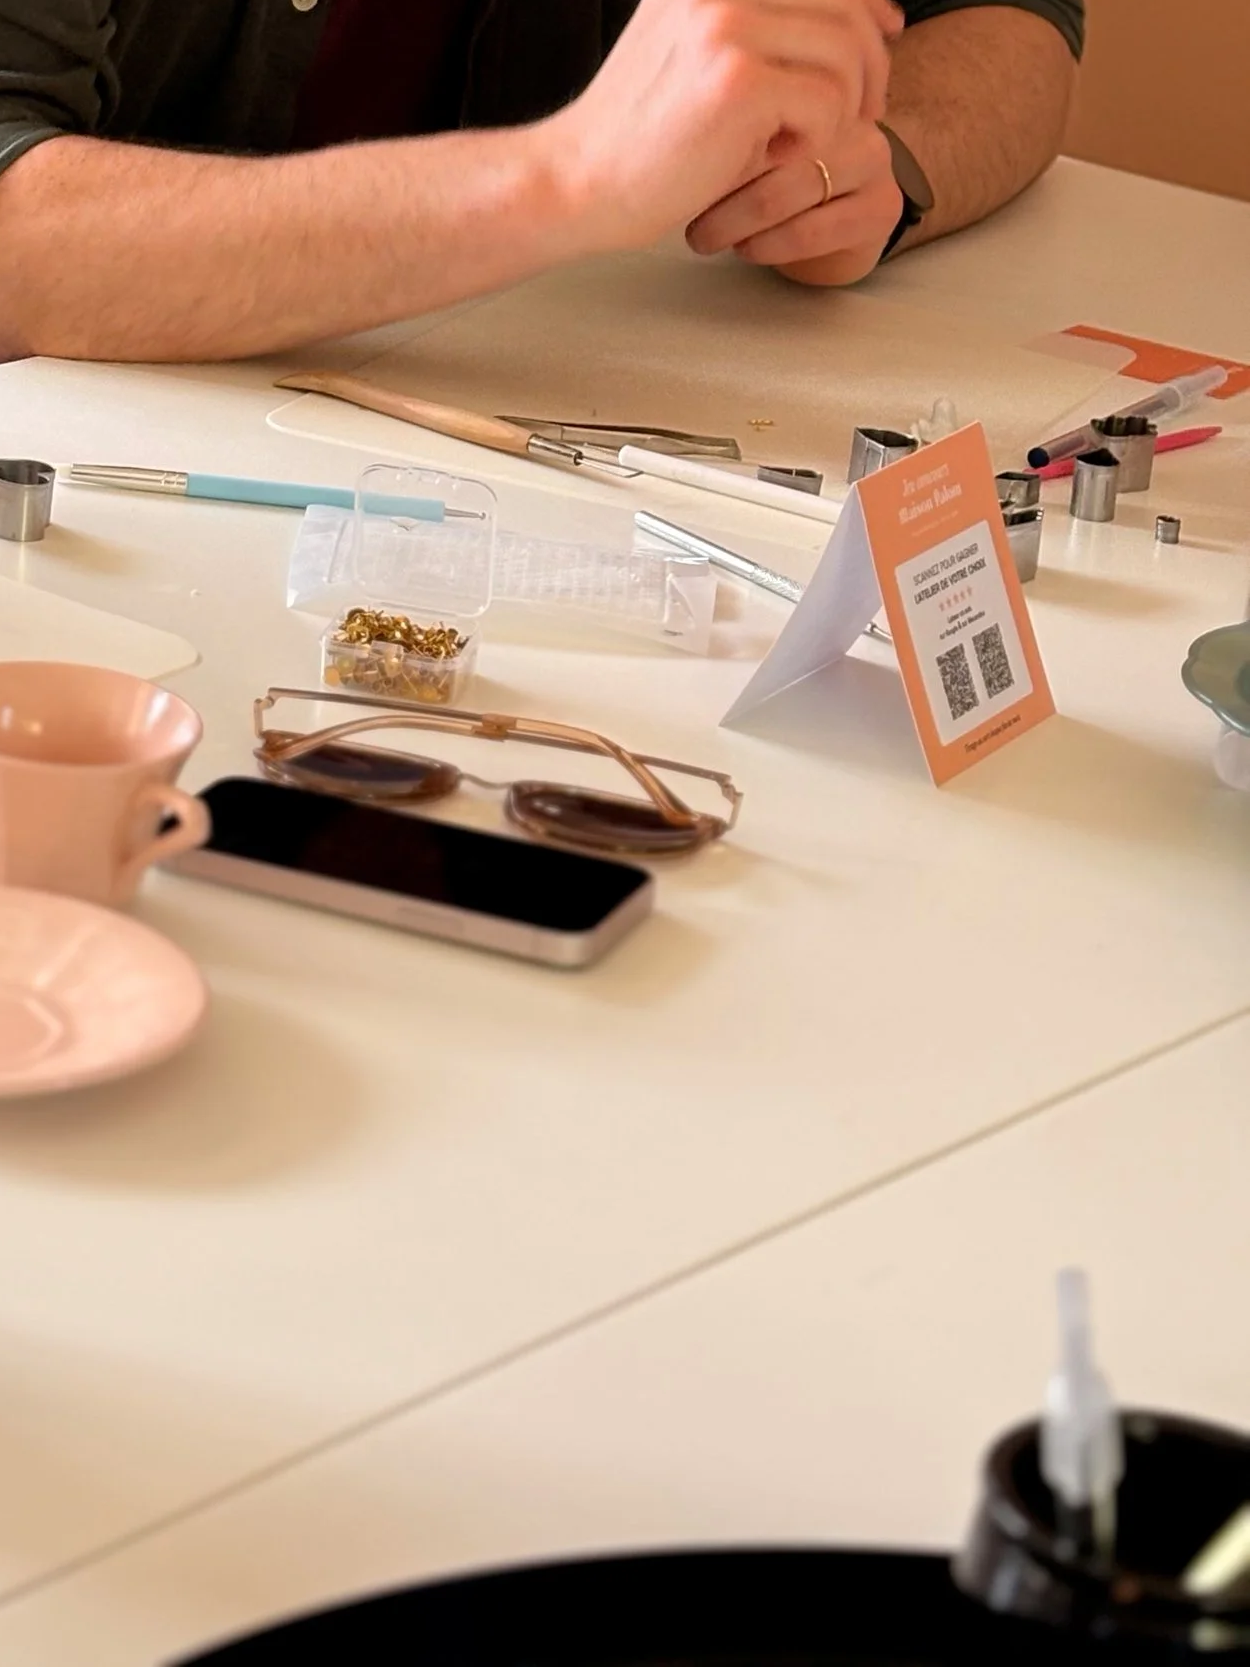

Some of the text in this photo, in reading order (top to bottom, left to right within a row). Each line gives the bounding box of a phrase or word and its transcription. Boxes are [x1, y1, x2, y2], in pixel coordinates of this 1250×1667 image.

[912, 542, 979, 586] SCANNEZ POUR GAGNER
[940, 577, 950, 590] DE
[949, 566, 968, 585] VOTRE
[967, 556, 987, 575] CHOIX
